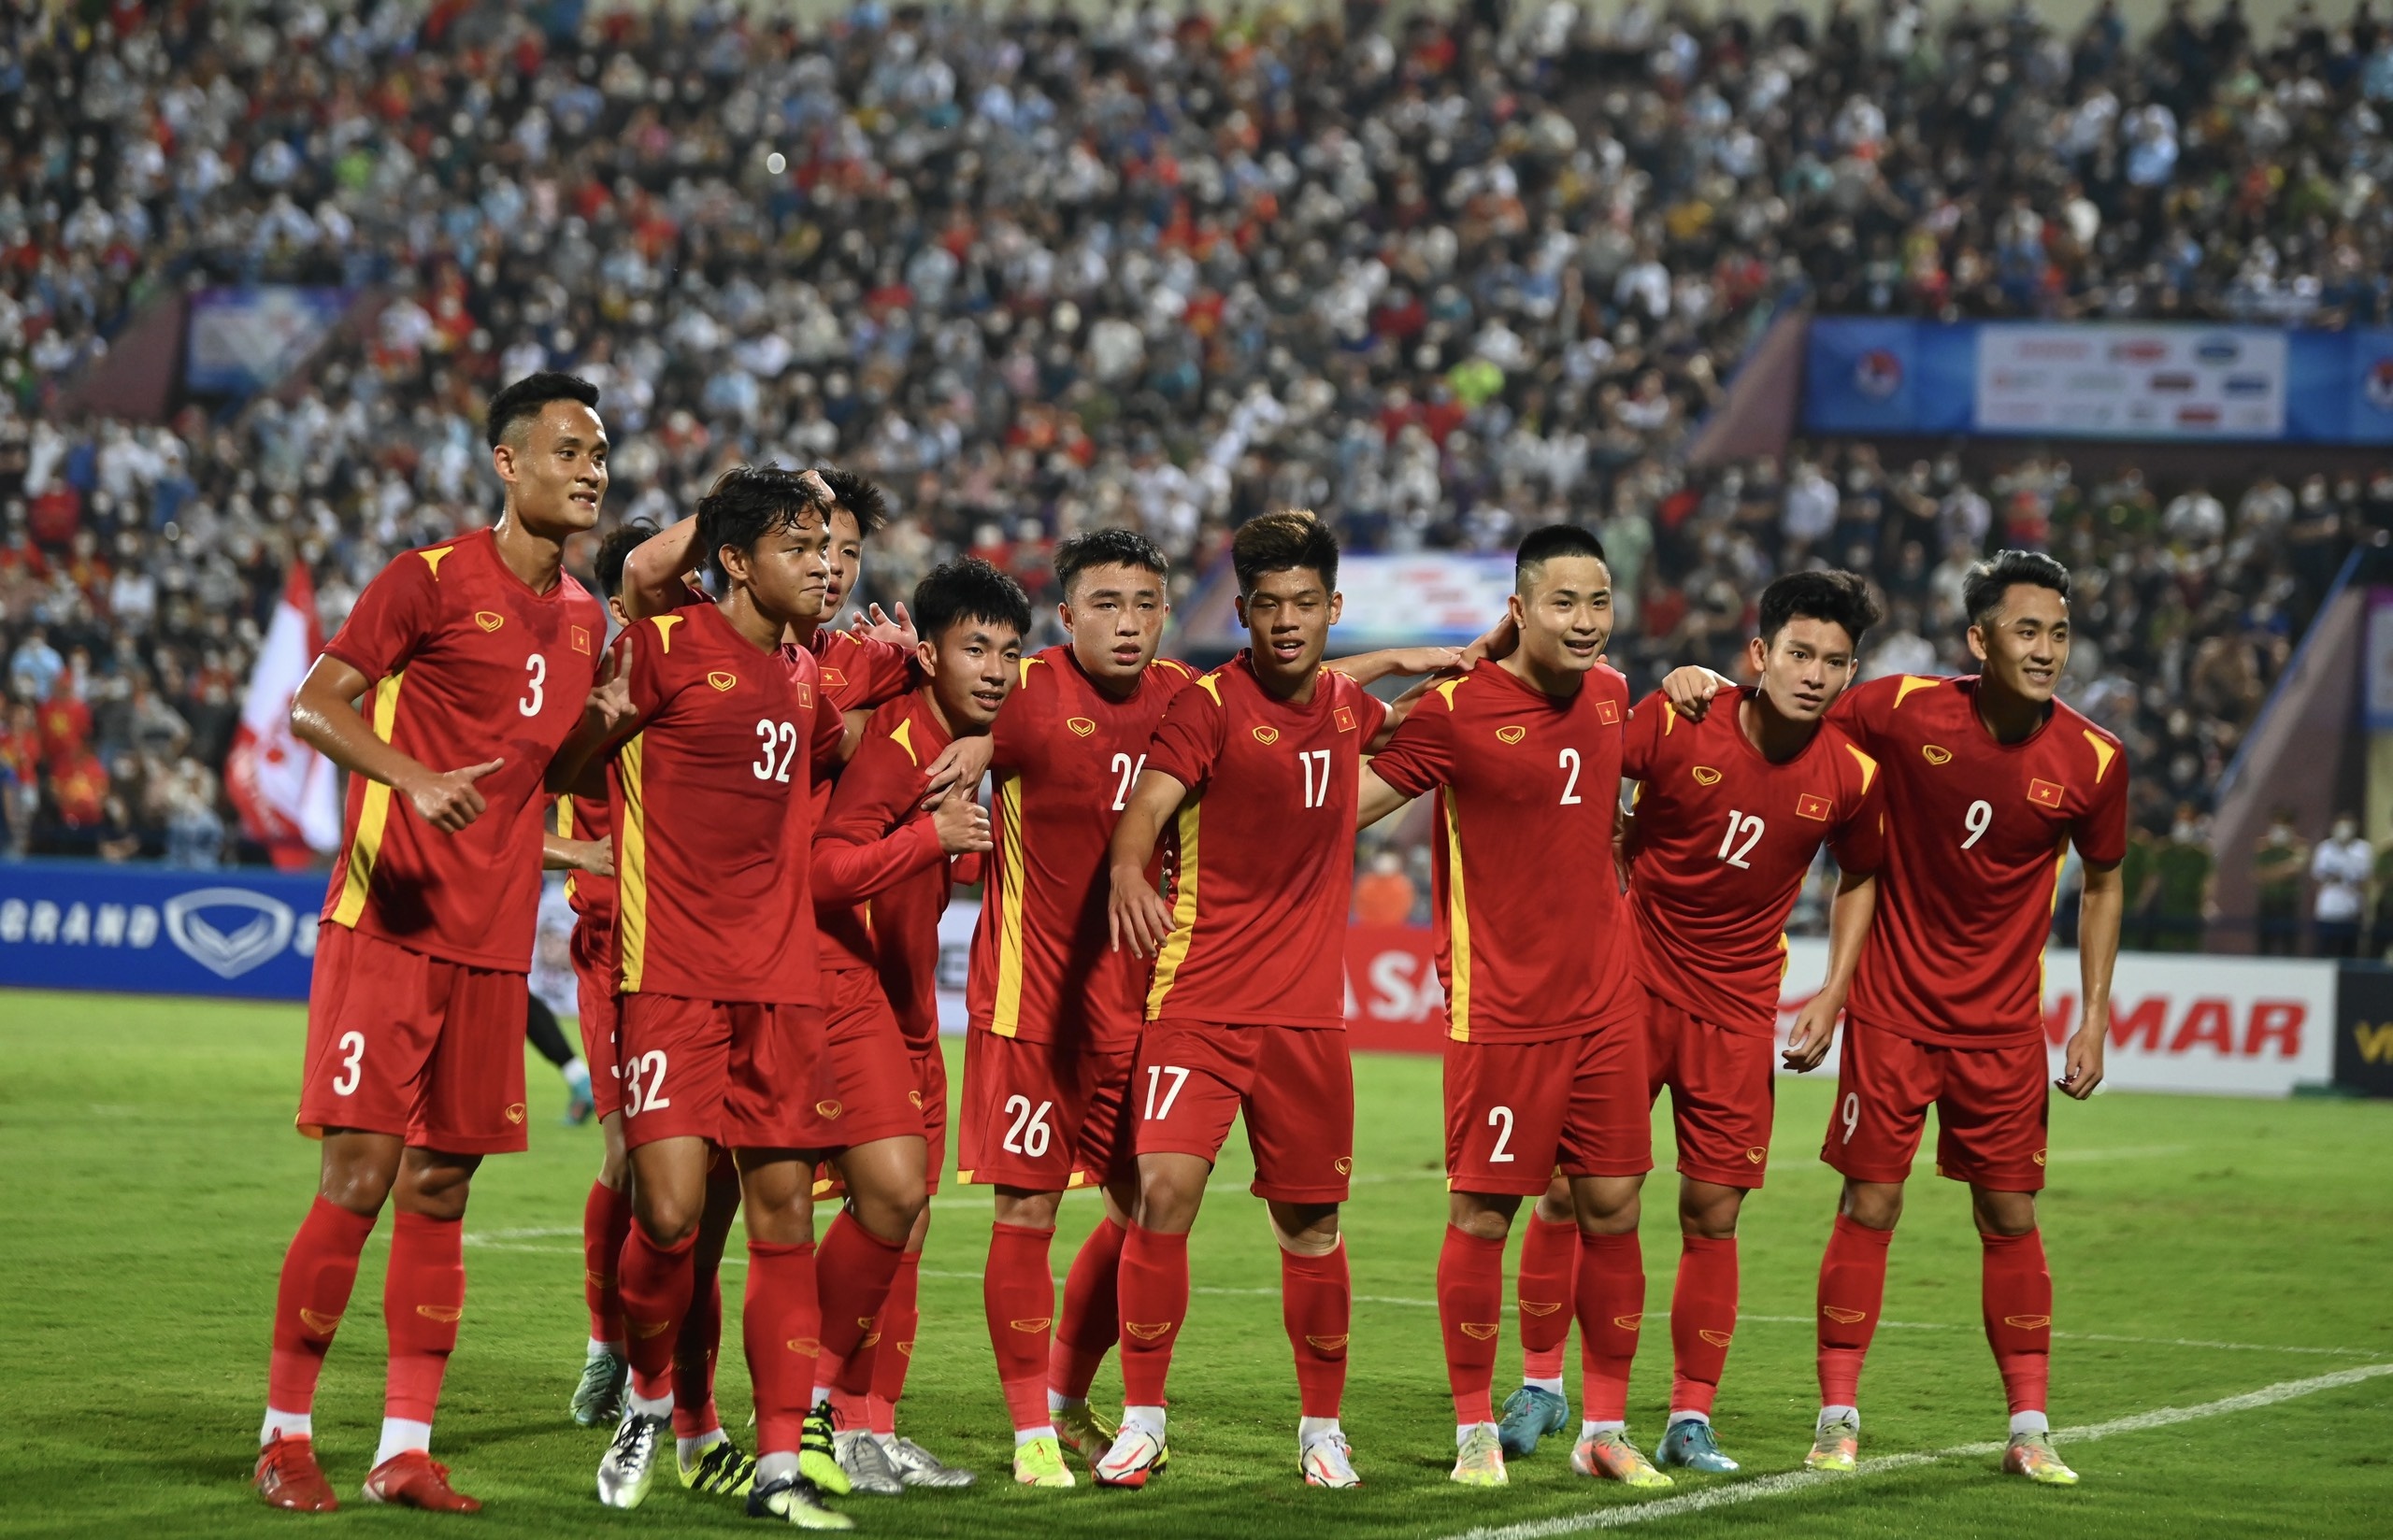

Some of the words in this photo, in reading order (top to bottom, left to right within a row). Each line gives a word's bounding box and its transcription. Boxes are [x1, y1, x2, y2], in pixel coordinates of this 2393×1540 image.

[519, 653, 547, 718] 3
[752, 718, 797, 783] 32
[1298, 749, 1331, 808] 17
[1558, 748, 1582, 806] 2
[1717, 809, 1766, 870] 12
[1960, 799, 1993, 849] 9
[0, 897, 160, 950] GRAND
[333, 1030, 365, 1097] 3
[624, 1049, 670, 1119] 32
[1143, 1065, 1191, 1120] 17
[1002, 1094, 1053, 1158] 26
[1488, 1105, 1514, 1162] 2
[1842, 1092, 1859, 1144] 9
